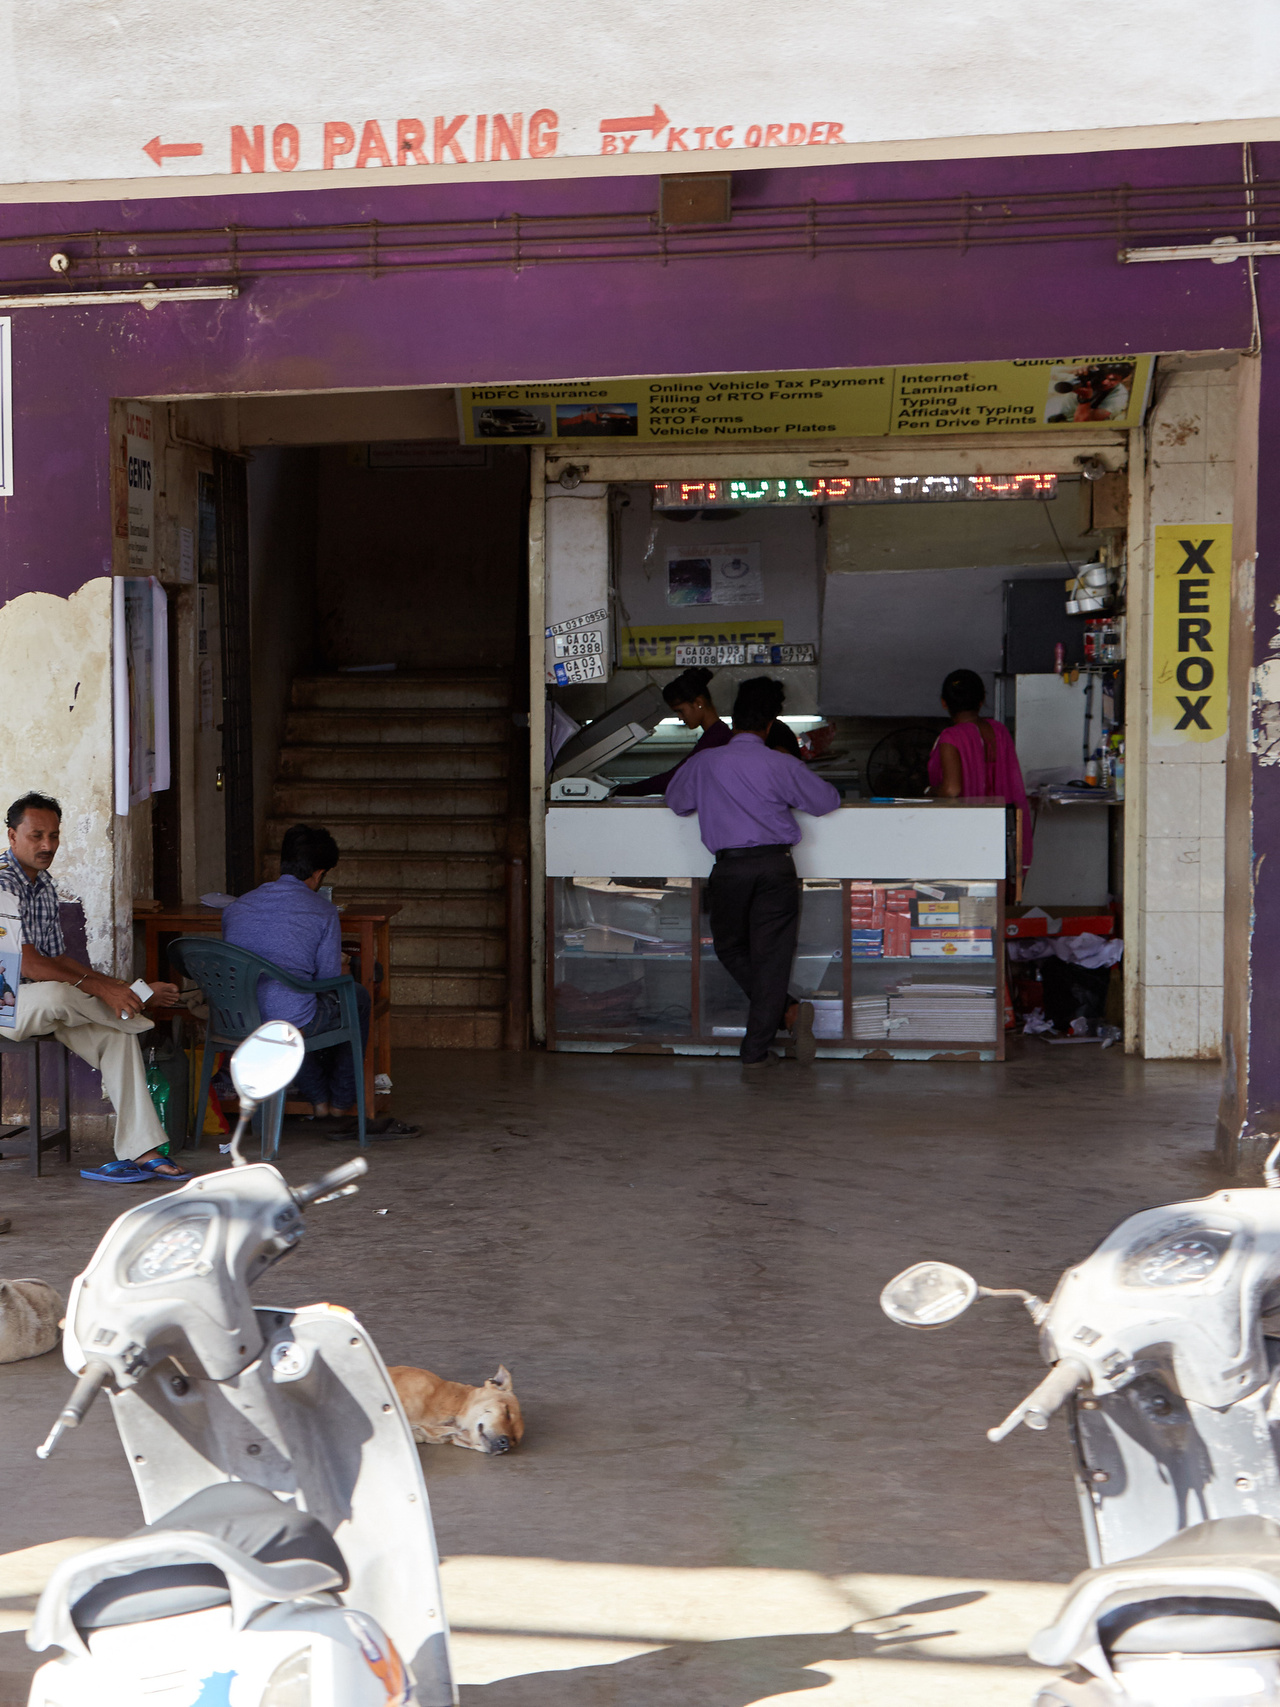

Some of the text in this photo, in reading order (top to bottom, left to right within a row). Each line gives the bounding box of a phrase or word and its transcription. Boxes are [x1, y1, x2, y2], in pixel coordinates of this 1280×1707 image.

[231, 108, 559, 174] NO PARKING
[601, 135, 639, 155] BY
[744, 121, 846, 147] ORDER
[902, 373, 969, 383] Internet
[649, 377, 885, 392] Online Vehicle Tax Payment
[901, 384, 998, 395] Lamination
[472, 390, 608, 400] HDFC Insurance
[650, 391, 823, 404] Filling of RTO Forms
[900, 397, 957, 408] Typing
[650, 406, 697, 414] Xerox
[898, 405, 1034, 417] Affidavit Typing
[650, 415, 743, 425] RTO Forms
[898, 416, 1037, 429] Pen Drive Prints
[650, 424, 836, 435] Vehicle Number Plates
[129, 455, 151, 491] GENTS
[566, 633, 596, 645] GA 02
[1174, 539, 1215, 730] XEROX
[685, 647, 712, 656] GA 03
[565, 657, 596, 672] GA 03
